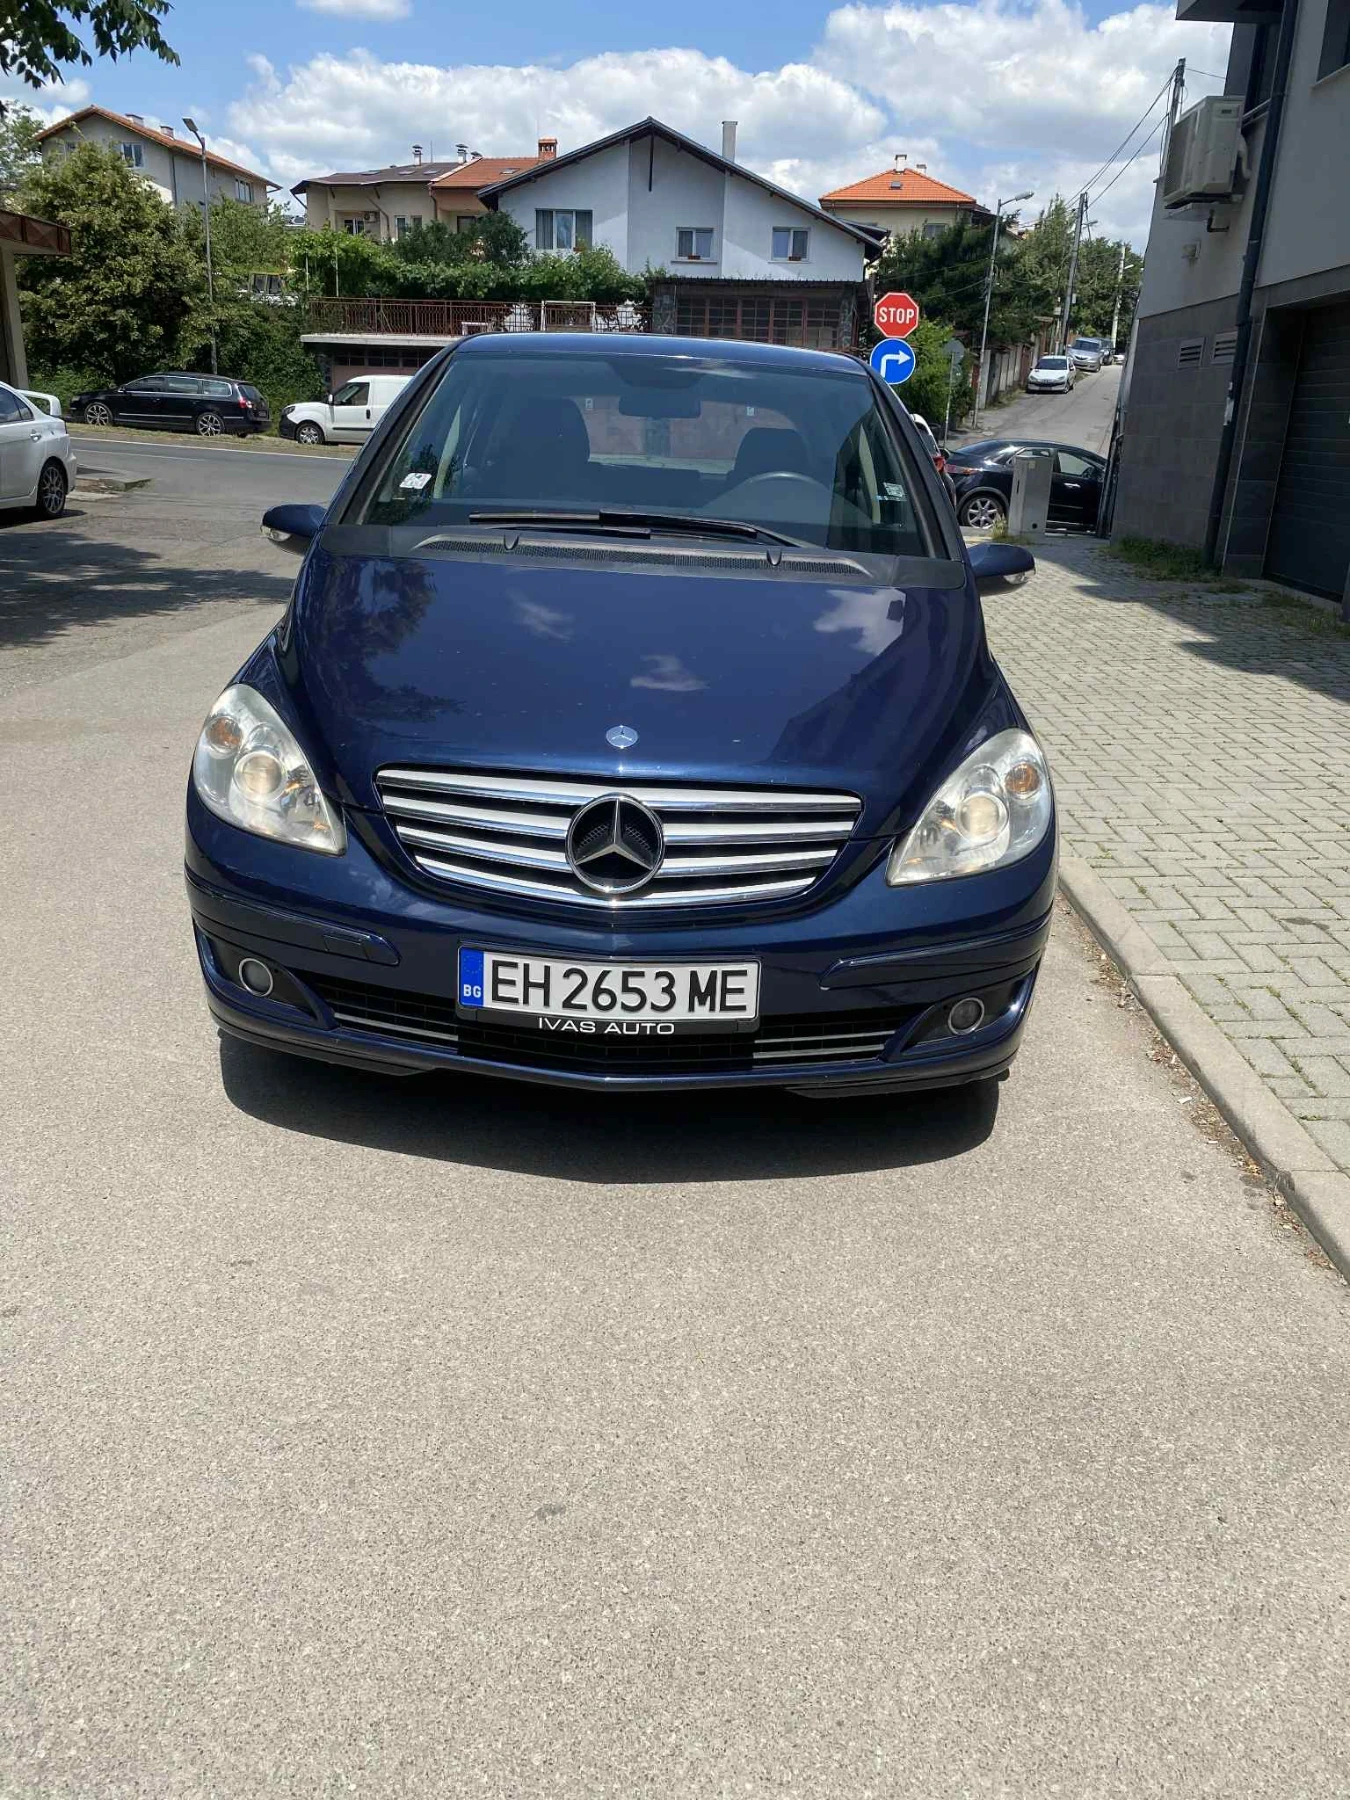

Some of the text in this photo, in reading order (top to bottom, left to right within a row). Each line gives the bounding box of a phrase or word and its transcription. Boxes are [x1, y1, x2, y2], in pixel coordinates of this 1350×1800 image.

[879, 307, 915, 324] STOP
[463, 984, 482, 998] BG
[491, 959, 748, 1012] EH 2653 ME
[538, 1017, 675, 1035] IVAS AUTO
